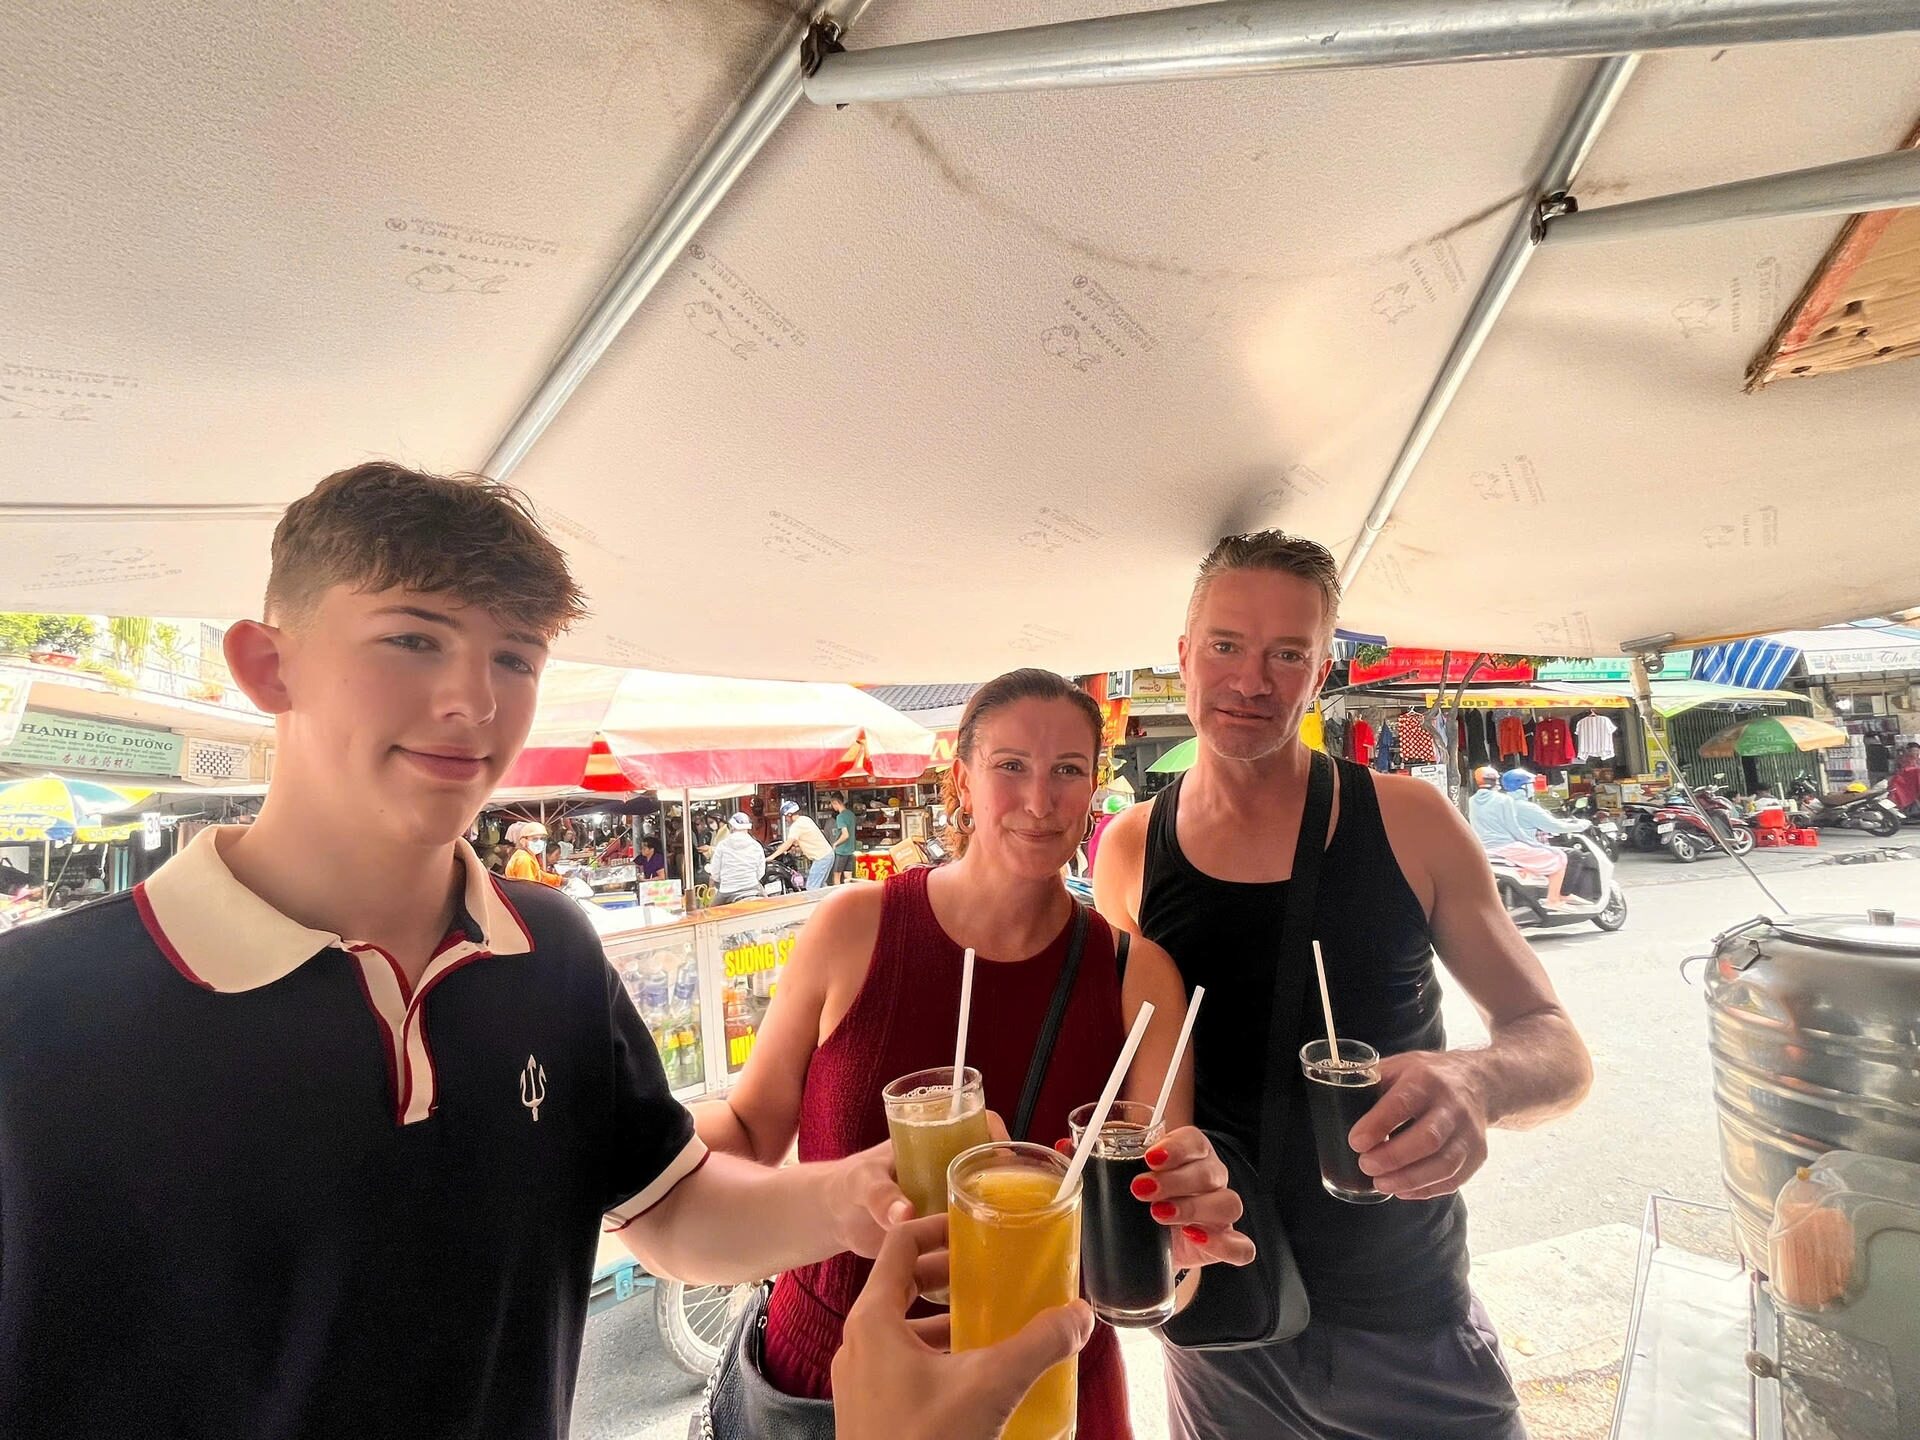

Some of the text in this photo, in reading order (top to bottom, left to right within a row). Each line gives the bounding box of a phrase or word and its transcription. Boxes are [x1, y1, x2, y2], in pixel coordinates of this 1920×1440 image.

[21, 723, 77, 741] HẠNH
[83, 731, 117, 745] ĐỨC
[123, 737, 174, 752] ĐƯỜNG
